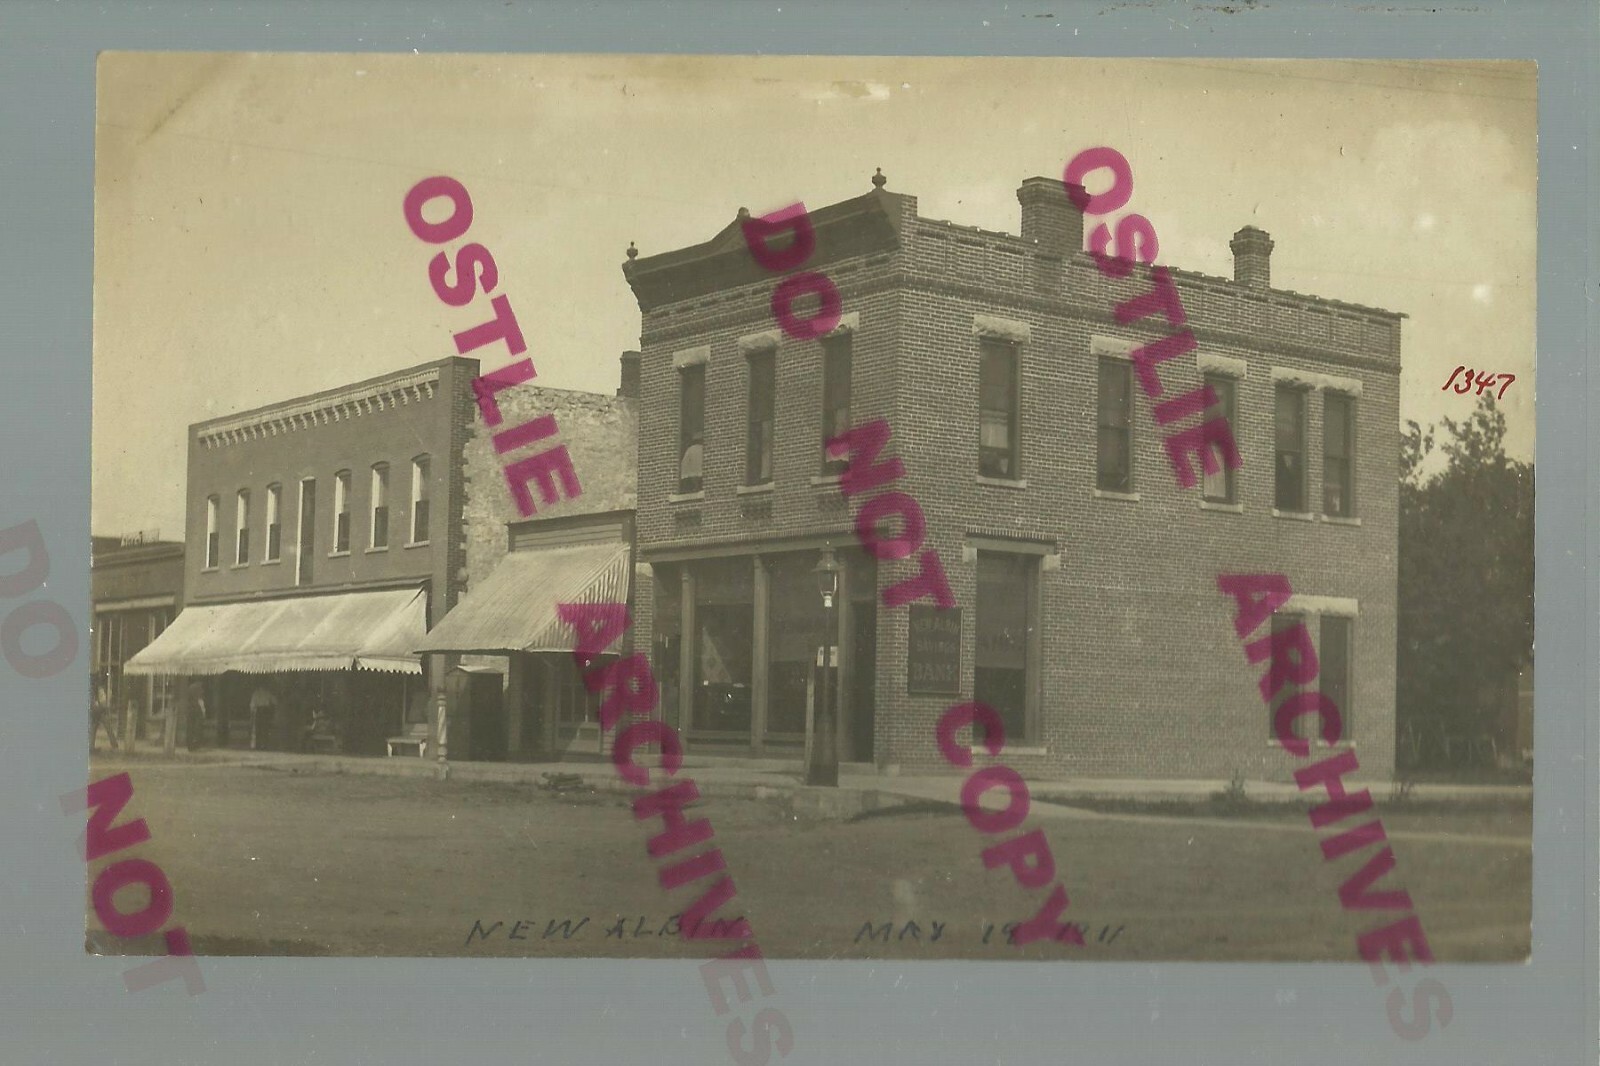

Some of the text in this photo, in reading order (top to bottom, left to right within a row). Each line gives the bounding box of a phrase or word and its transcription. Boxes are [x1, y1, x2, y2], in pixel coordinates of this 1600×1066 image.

[1441, 365, 1516, 400] 1347
[466, 917, 590, 944] NEW
[605, 912, 745, 939] ALBIN
[854, 920, 945, 944] MAY
